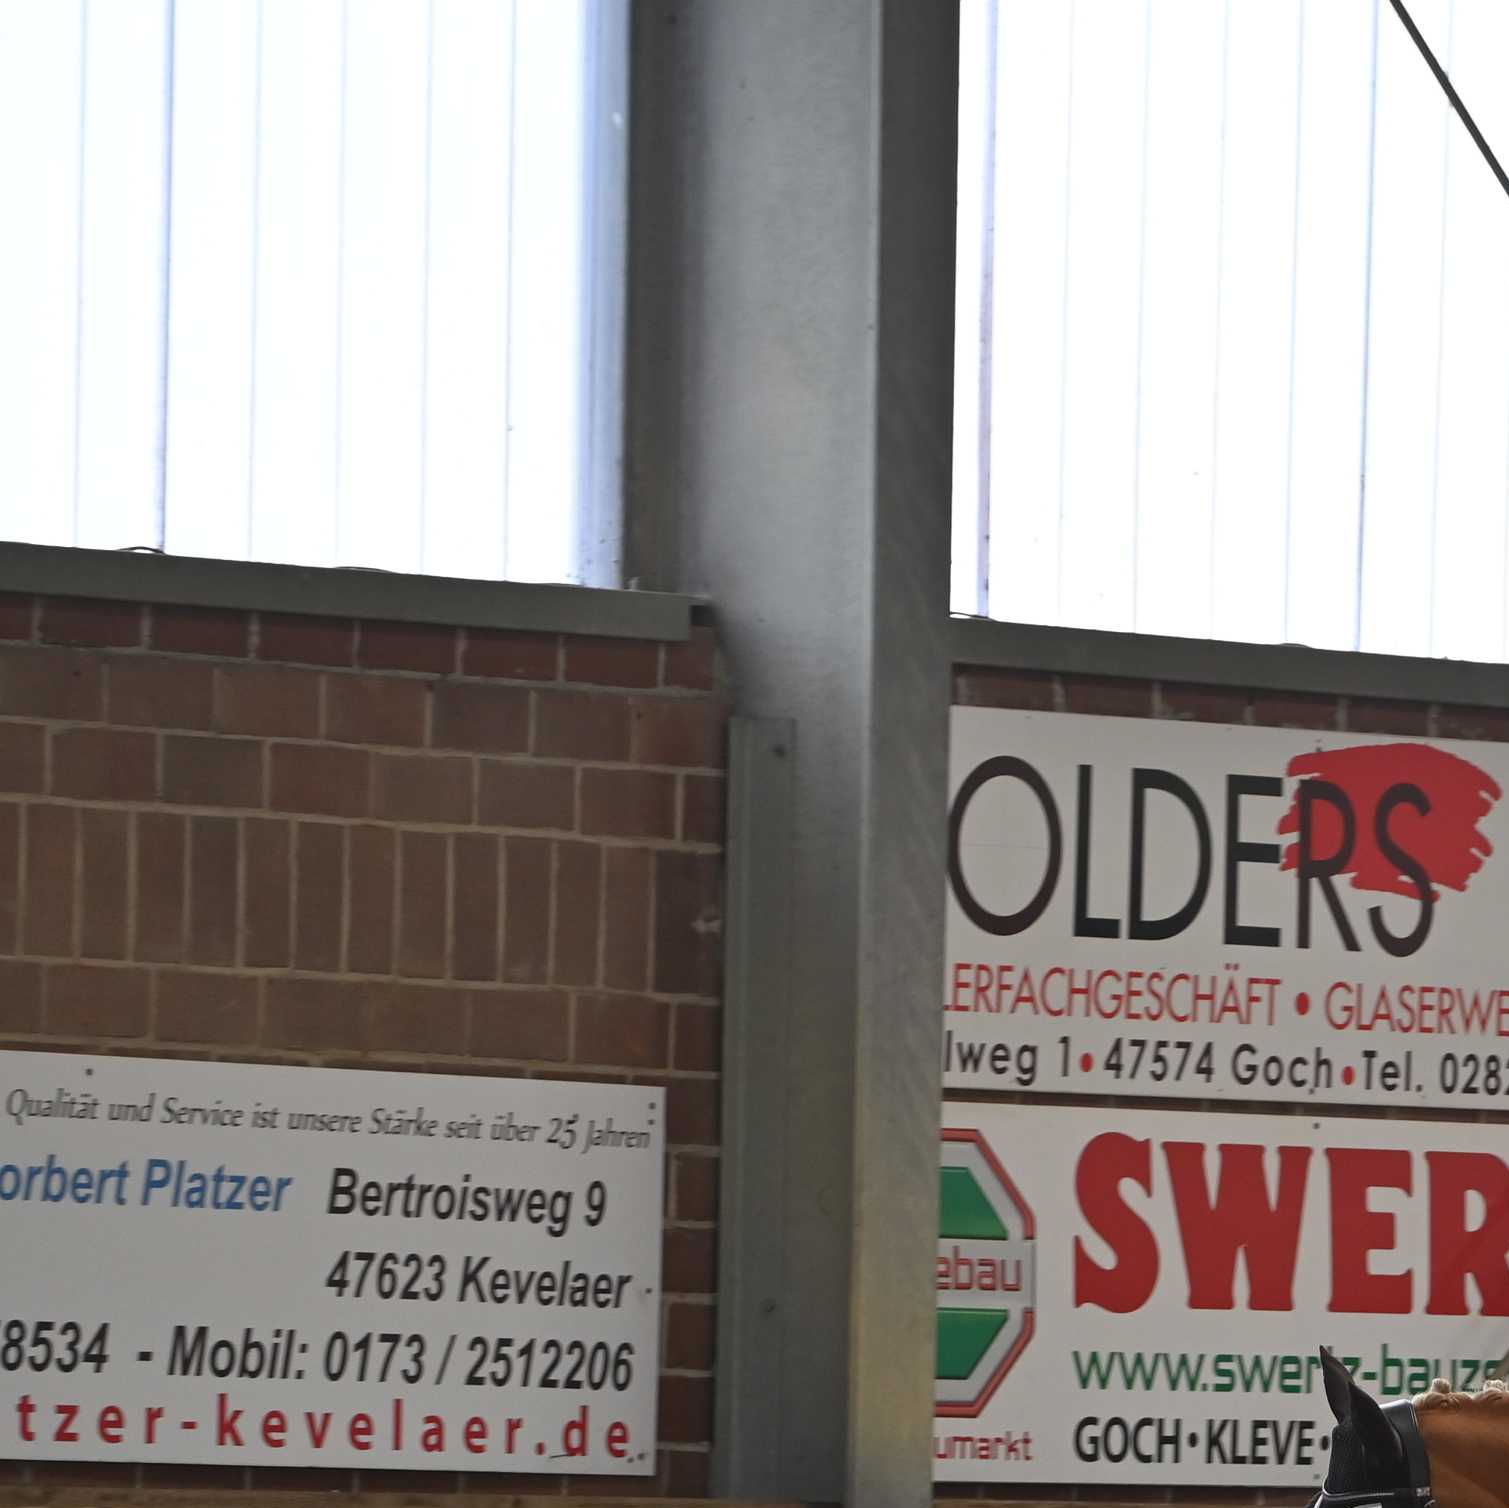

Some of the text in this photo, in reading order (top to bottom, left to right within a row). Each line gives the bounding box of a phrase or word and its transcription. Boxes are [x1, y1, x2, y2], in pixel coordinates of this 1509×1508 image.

[1059, 1036, 1071, 1077] 1
[1104, 1037, 1215, 1083] 47574
[1232, 1043, 1332, 1090] Goch
[1363, 1049, 1423, 1092] Tel.
[5, 1087, 651, 1154] Qualität und Service ist unsere Stärke seit über 25 Jahren
[0, 1153, 608, 1238] orbert Platzer Bertroisweg 9
[325, 1248, 632, 1310] 47623 Kevelaer
[0, 1318, 111, 1374] 8534
[167, 1325, 310, 1380] Mobil:
[323, 1329, 427, 1384] 0173
[465, 1335, 635, 1392] 2512206
[1074, 1416, 1316, 1466] GOCH KLEVE
